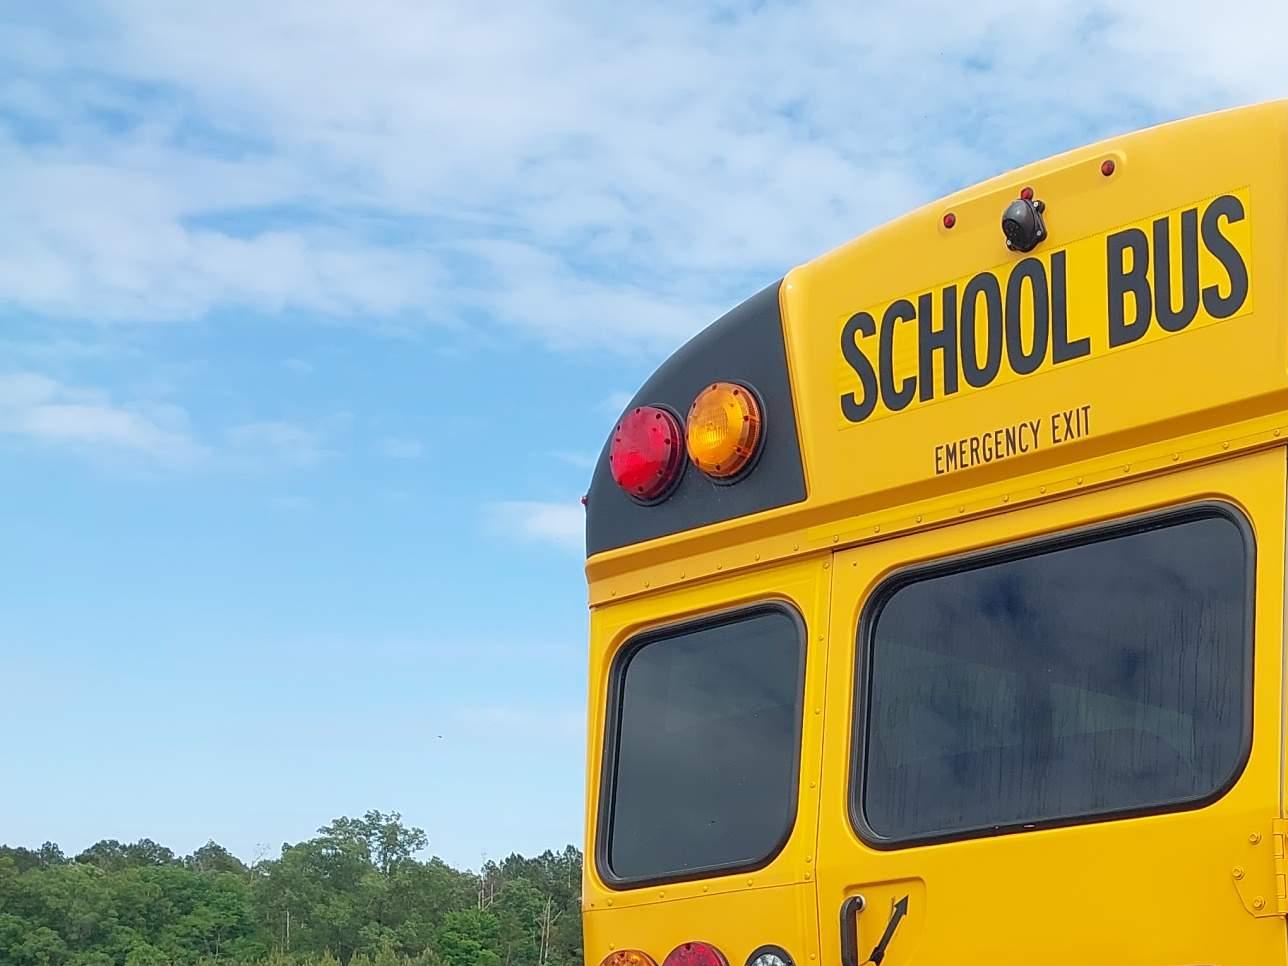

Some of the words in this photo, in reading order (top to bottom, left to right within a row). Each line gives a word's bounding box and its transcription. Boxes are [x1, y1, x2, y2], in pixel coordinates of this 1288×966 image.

[840, 250, 1091, 423] SCHOOL
[1106, 194, 1249, 349] BUS
[934, 419, 1041, 475] EMERGENCY
[1051, 405, 1092, 444] EXIT
